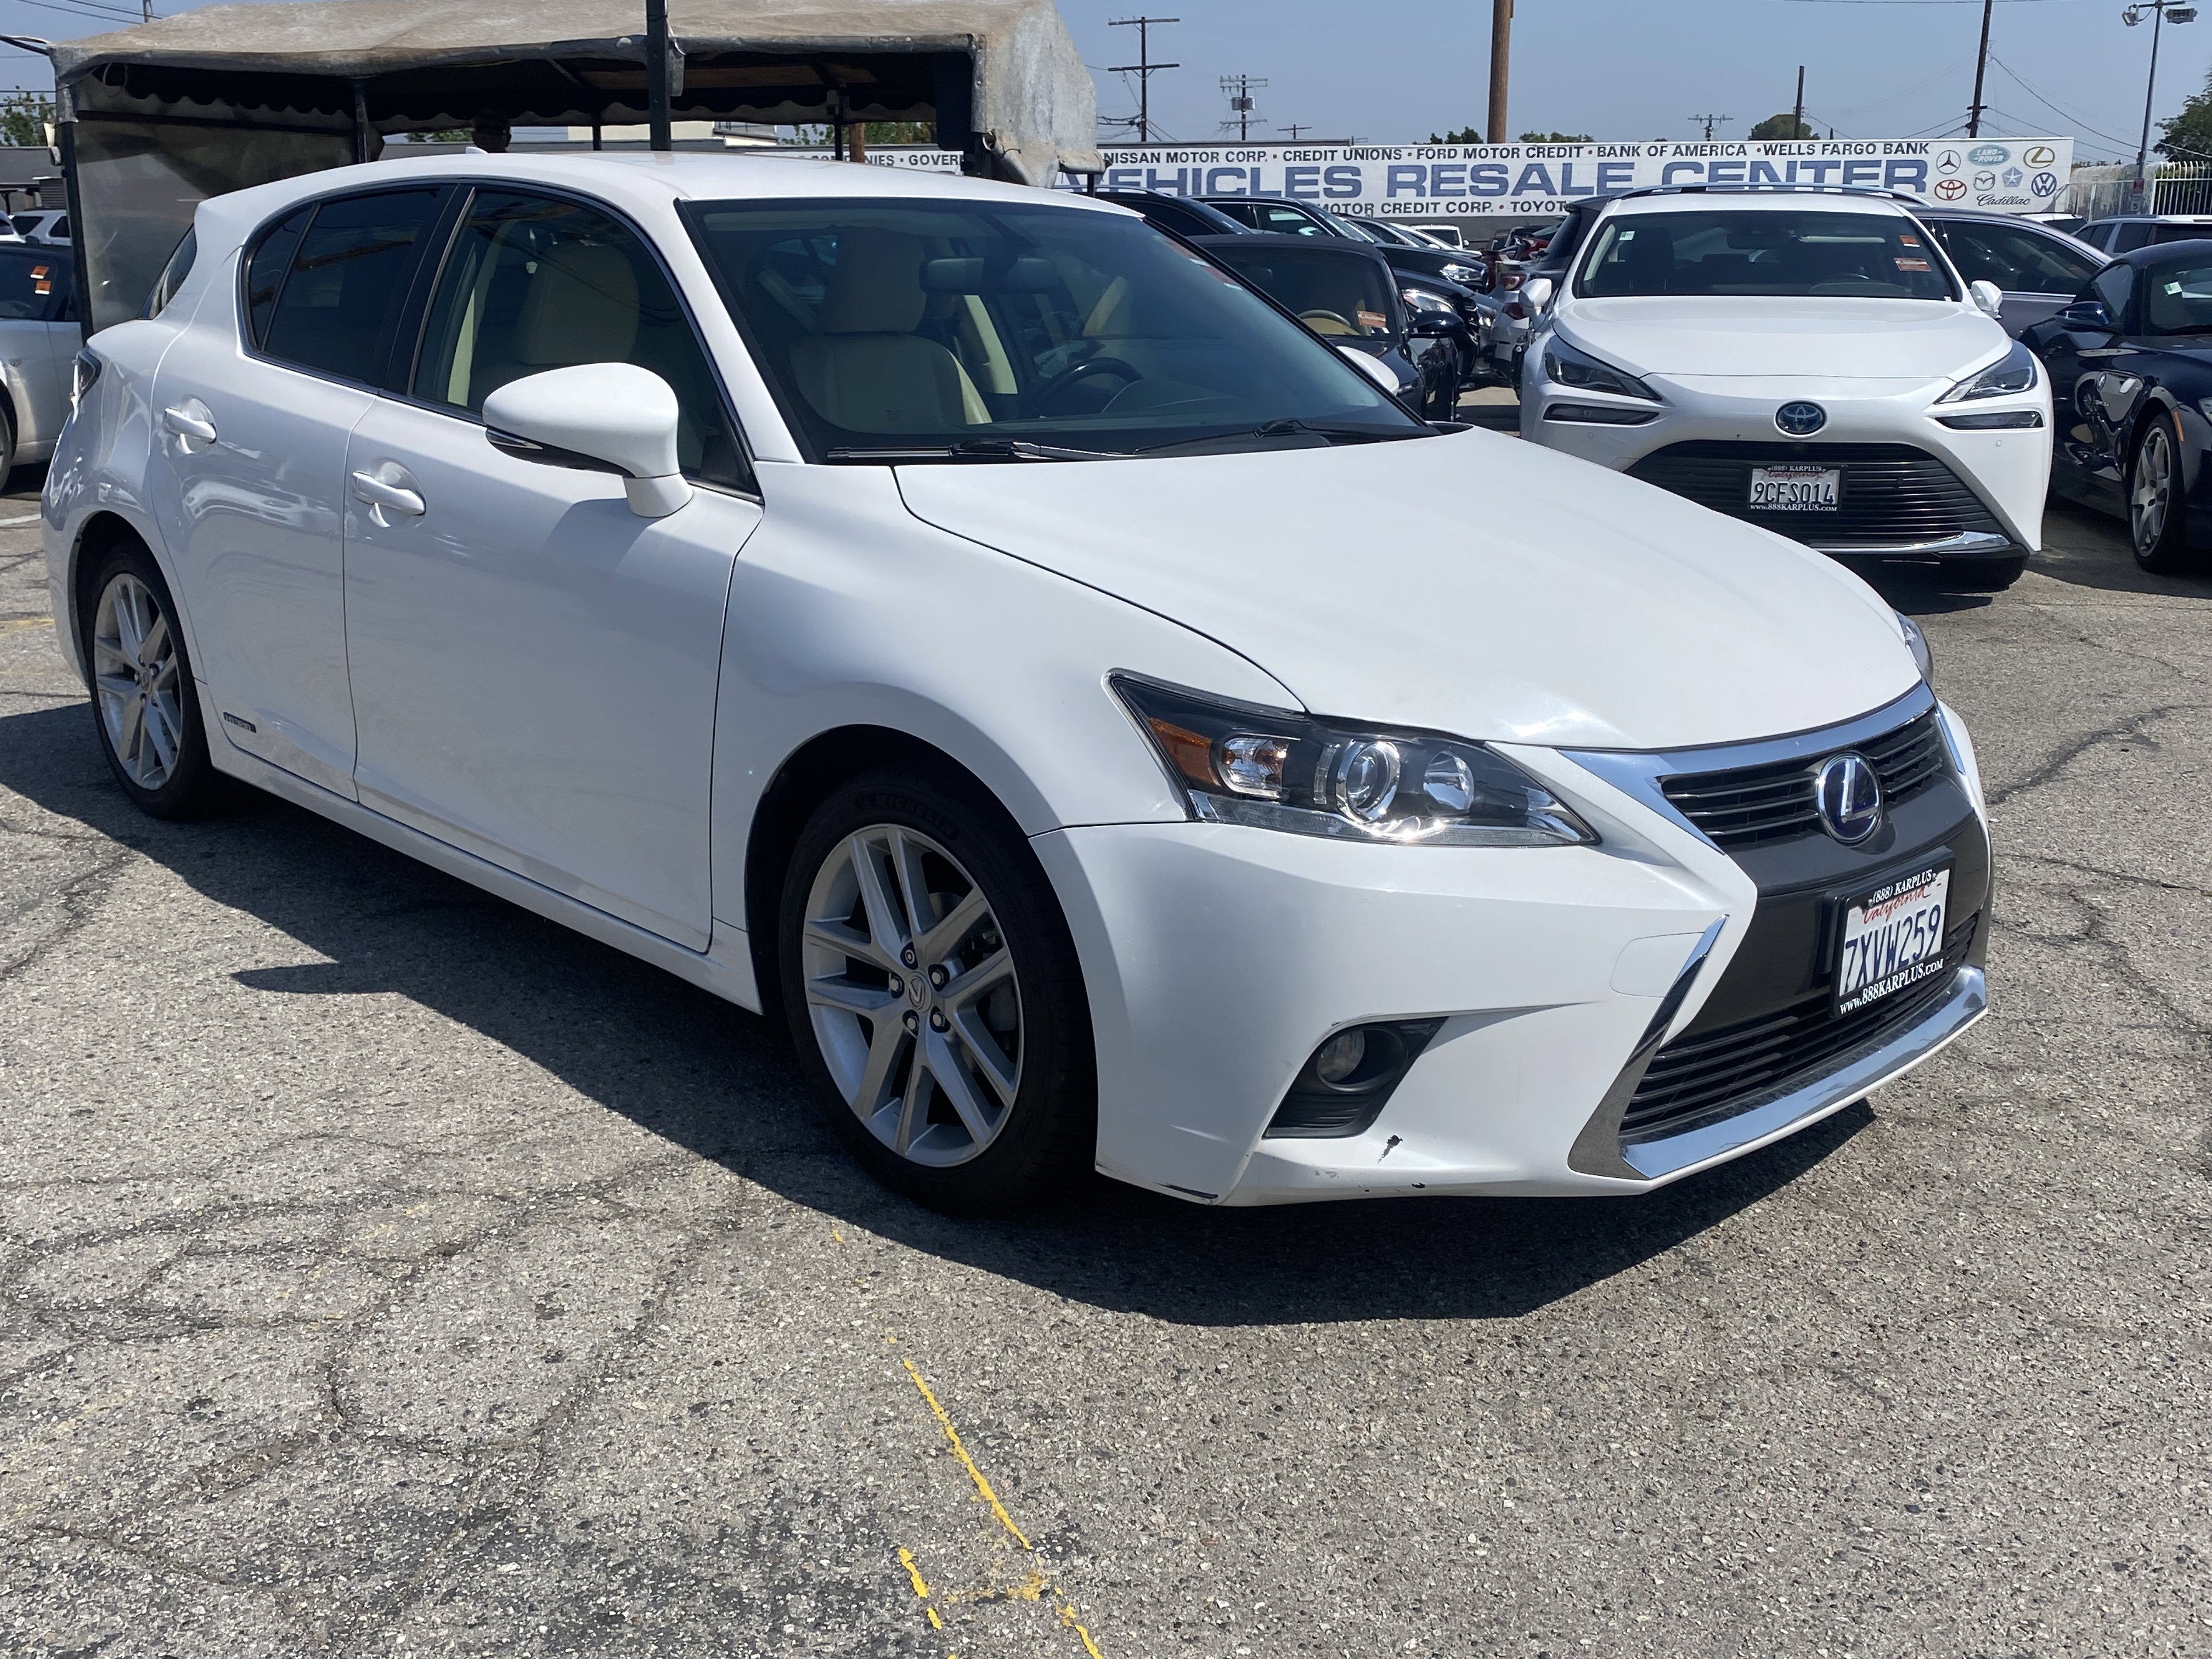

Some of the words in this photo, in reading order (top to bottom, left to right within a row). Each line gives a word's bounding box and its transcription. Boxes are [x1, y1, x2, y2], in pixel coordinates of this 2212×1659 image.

[1283, 150, 1338, 162] CREDIT
[1343, 149, 1402, 161] UNIONS
[1417, 148, 1457, 160] FORD
[1463, 148, 1520, 159] MOTOR
[1526, 146, 1584, 158] CREDIT
[1597, 145, 1641, 157] BANK
[1647, 145, 1668, 157] OF
[1673, 144, 1747, 156] AMERICA
[1763, 144, 1816, 156] WELLS
[1821, 143, 1877, 155] FARGO
[1883, 143, 1930, 155] BANK
[1103, 152, 1161, 163] NISSAN
[1166, 151, 1220, 163] MOTOR
[1226, 151, 1268, 162] CORP.
[1387, 162, 1635, 198] RESALE
[1662, 159, 1929, 193] CENTER
[1510, 200, 1567, 212] TOYOT
[1976, 194, 2031, 207] Cadillac
[1380, 202, 1441, 214] CREDIT
[1446, 201, 1493, 213] CORP.
[1872, 885, 1894, 904] (888)
[1894, 868, 1933, 896] KARPLUS
[1863, 886, 1931, 924] California
[1844, 904, 1941, 994] 7XVW259
